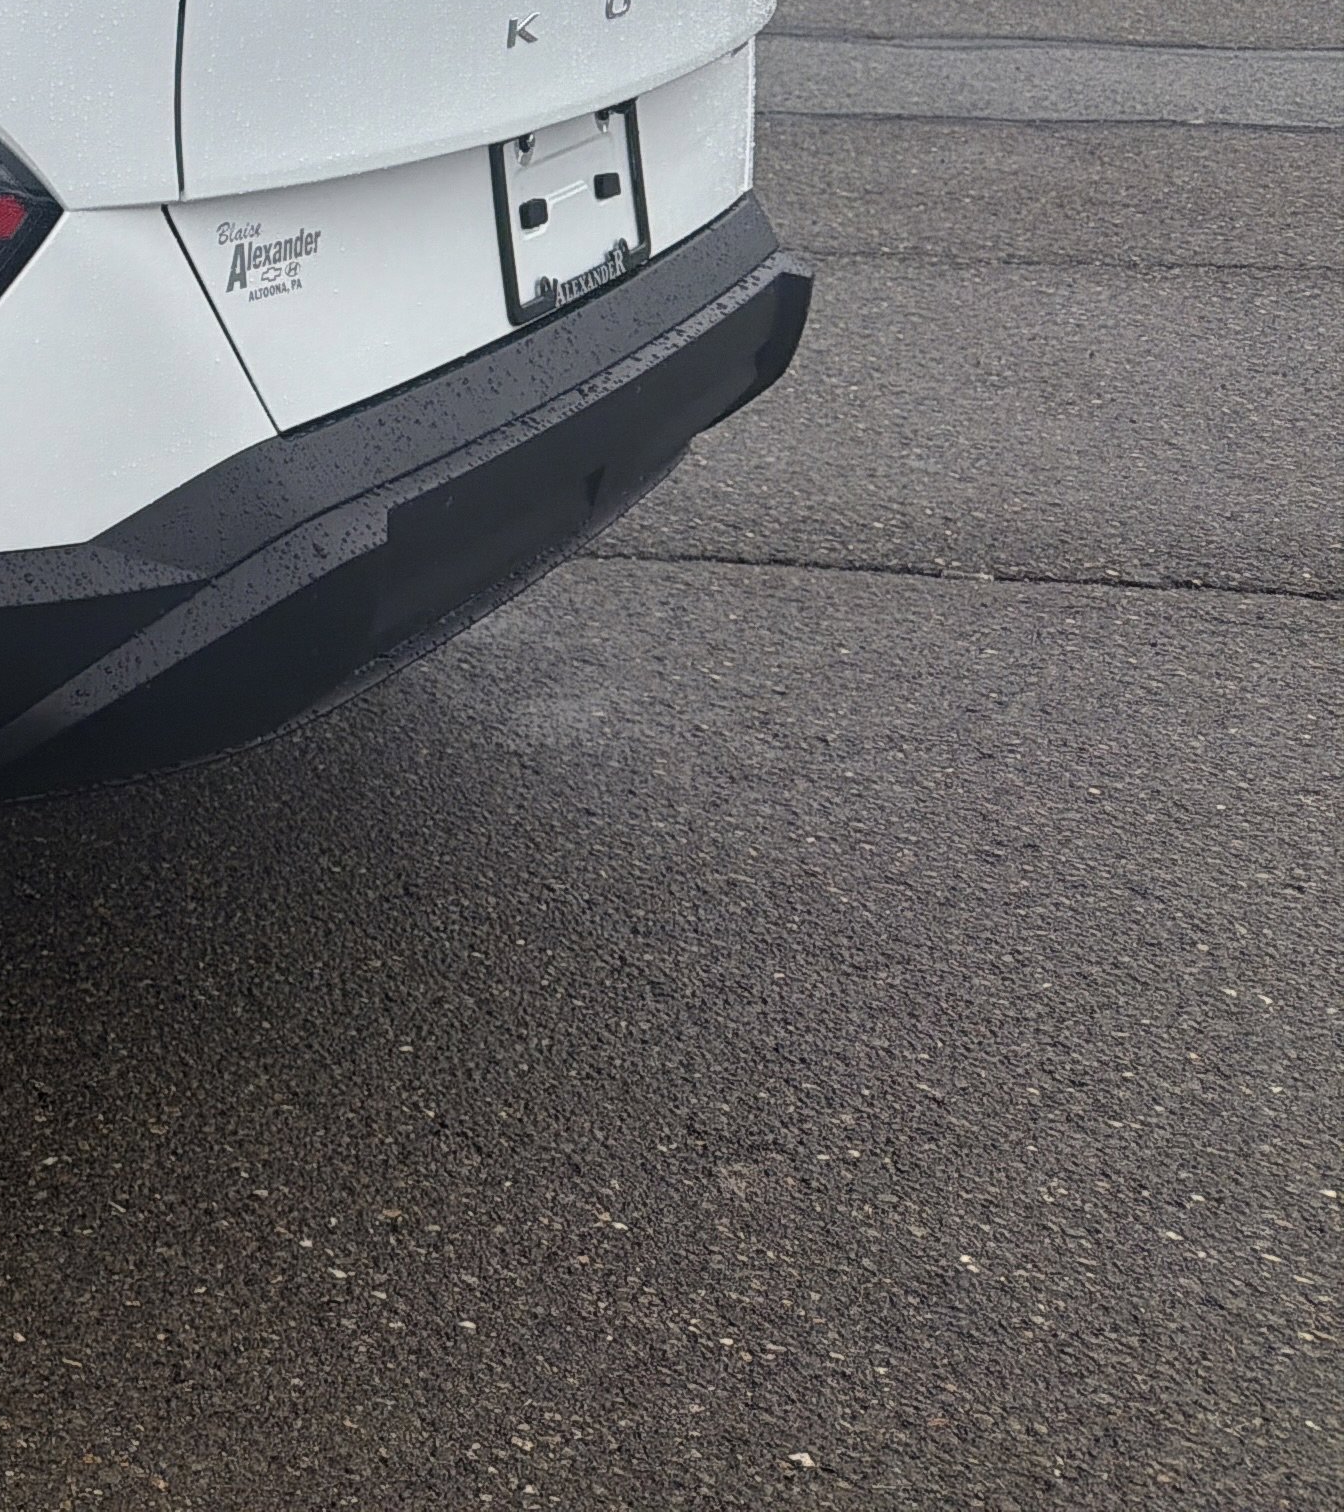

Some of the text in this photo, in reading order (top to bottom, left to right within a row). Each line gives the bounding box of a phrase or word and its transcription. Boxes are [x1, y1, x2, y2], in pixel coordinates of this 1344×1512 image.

[226, 228, 321, 293] Alexander
[291, 279, 303, 291] PA
[555, 249, 627, 309] ALEXANDER
